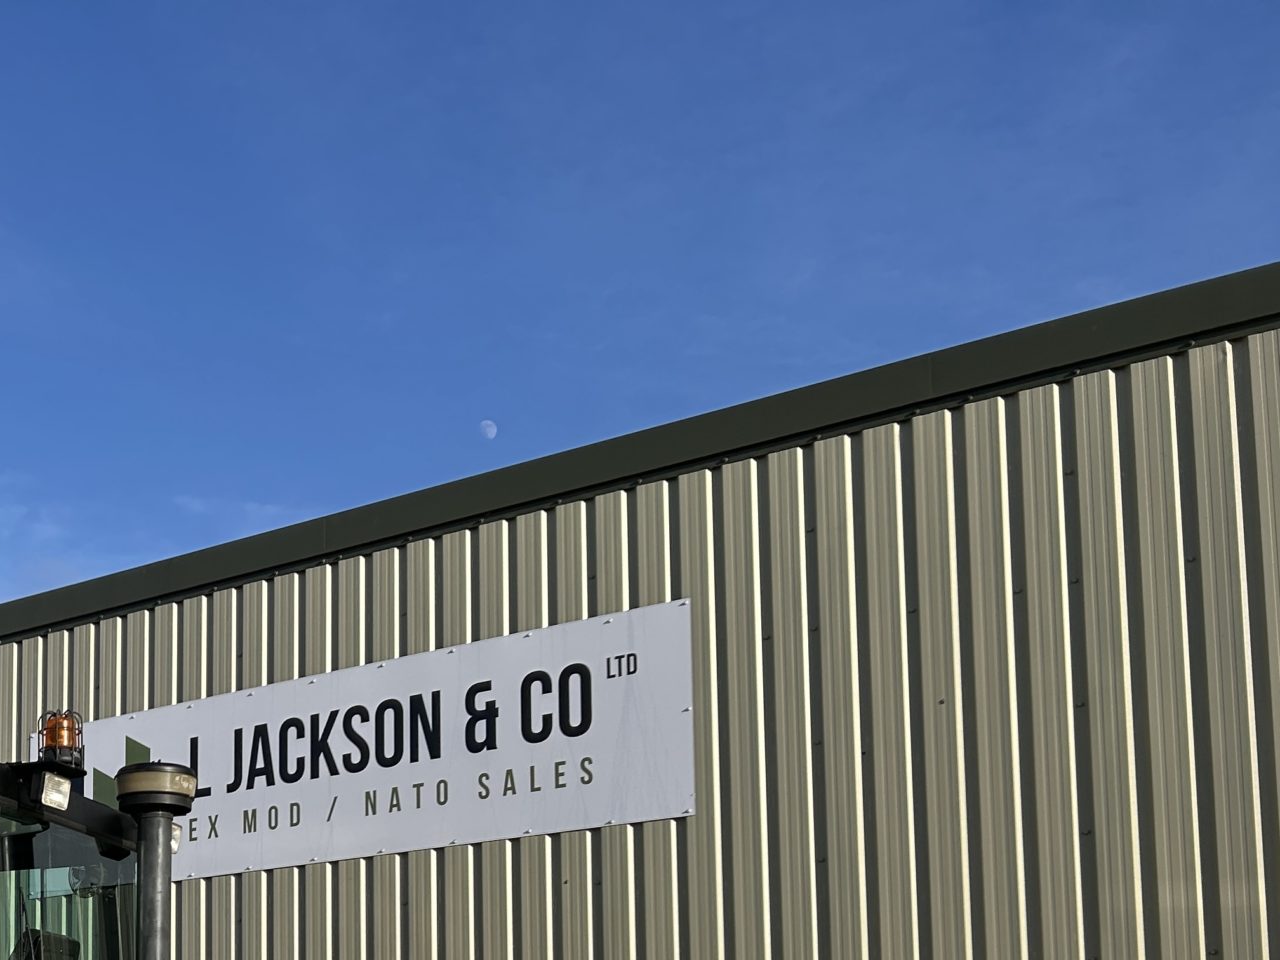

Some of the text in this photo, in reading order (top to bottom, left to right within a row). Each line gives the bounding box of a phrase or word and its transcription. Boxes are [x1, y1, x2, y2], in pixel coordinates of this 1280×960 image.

[226, 689, 442, 794] JACKSON
[464, 679, 500, 754] &
[520, 662, 593, 744] CO
[606, 652, 638, 680] LTD
[188, 756, 594, 842] EX MOD / NATO SALES
